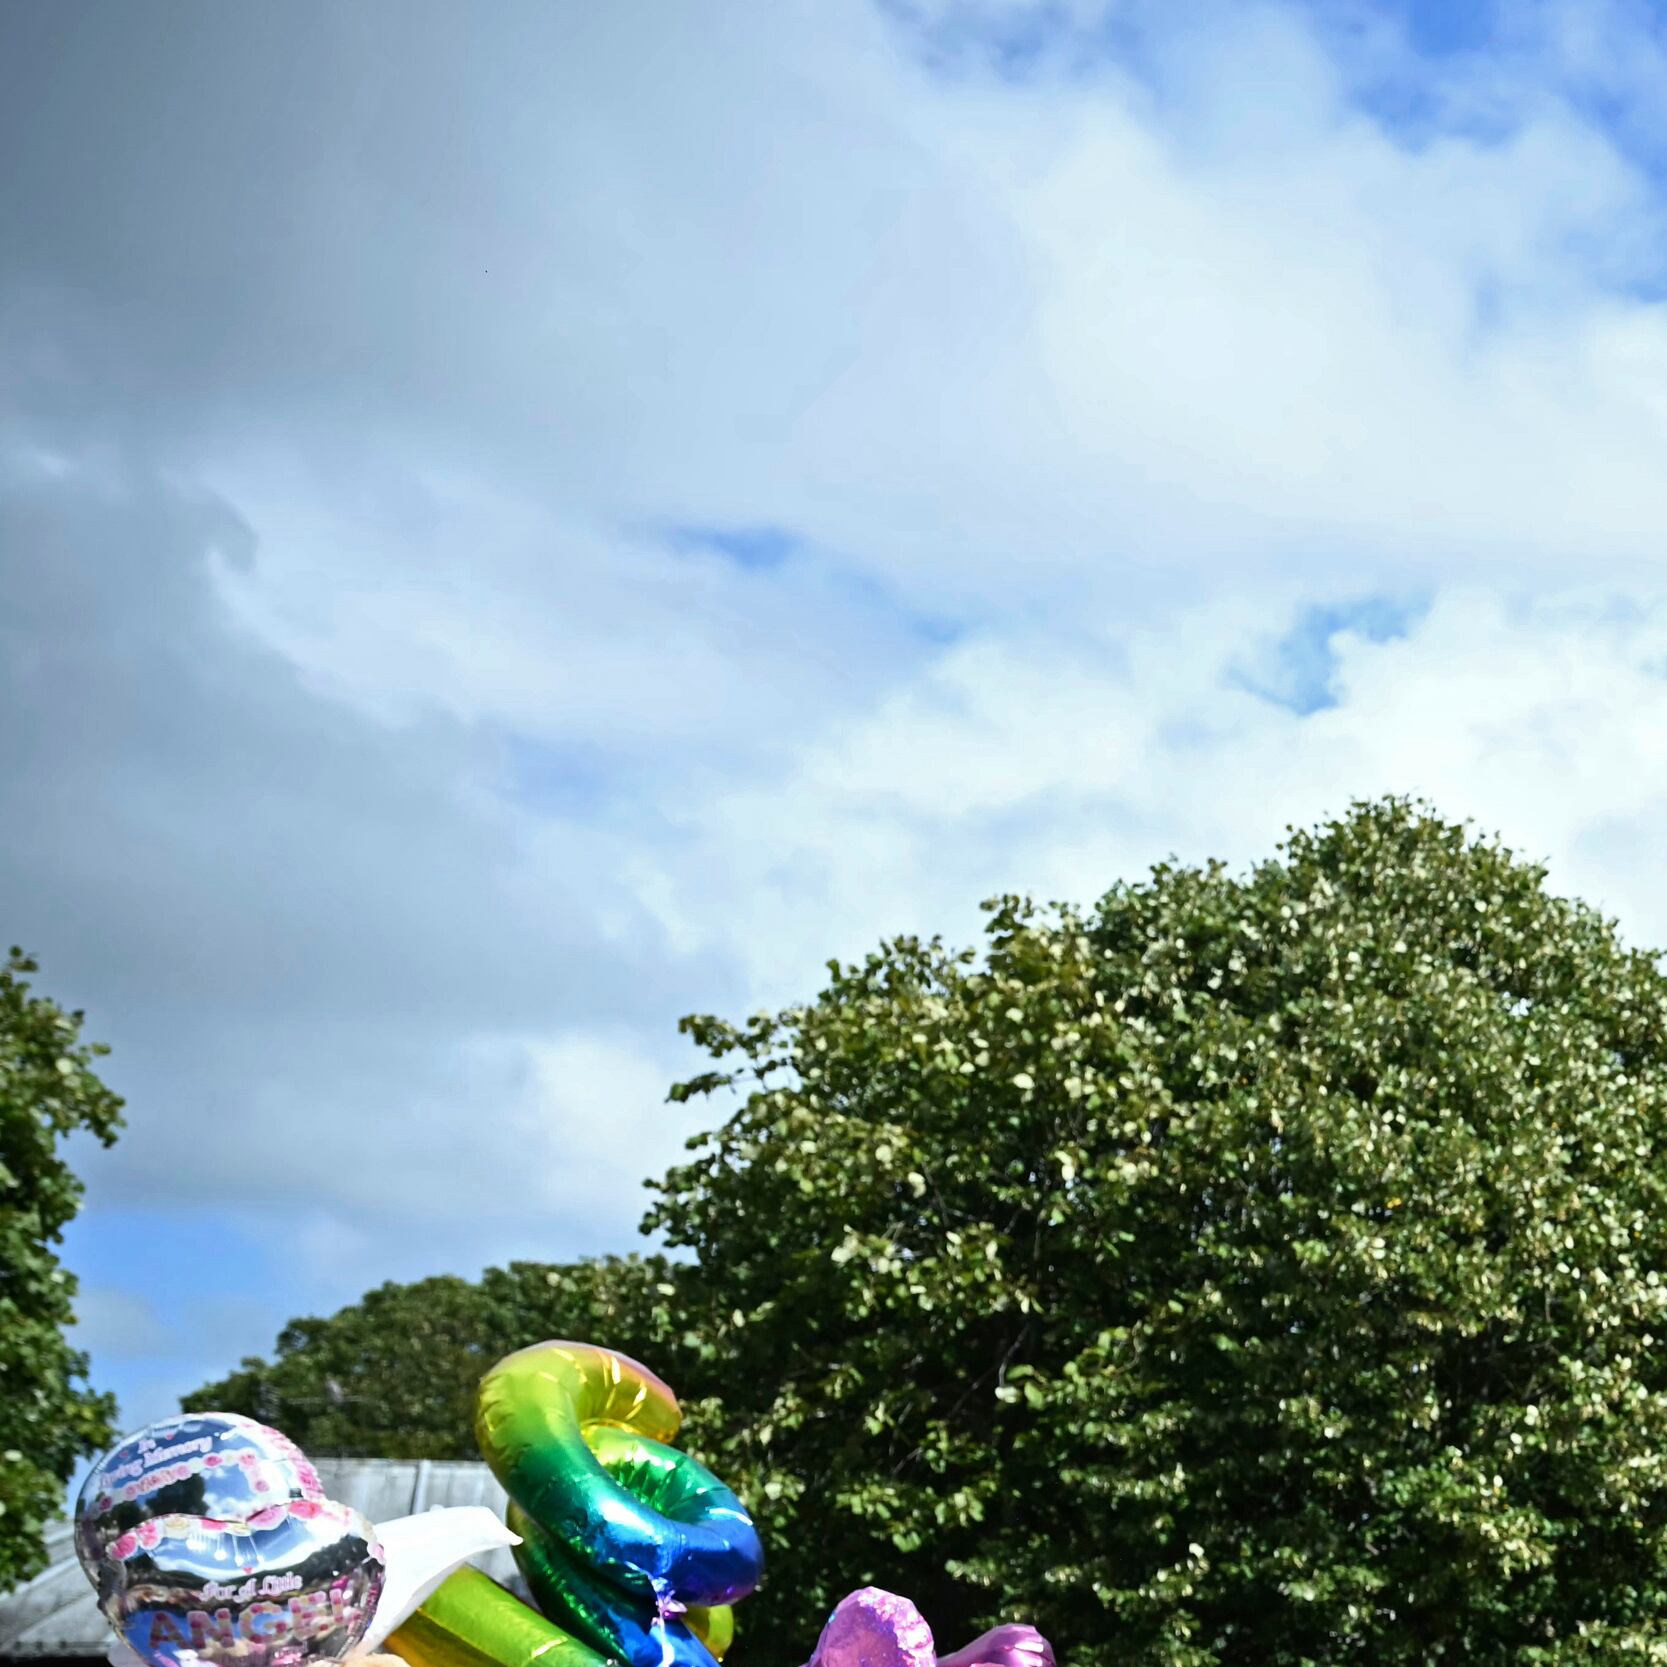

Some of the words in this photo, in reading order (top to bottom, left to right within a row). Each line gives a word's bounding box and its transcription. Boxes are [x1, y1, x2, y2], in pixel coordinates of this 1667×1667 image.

[143, 1436, 213, 1468] Memory
[199, 1580, 237, 1602] For
[258, 1571, 304, 1597] Little
[148, 1588, 351, 1649] ANGEL
